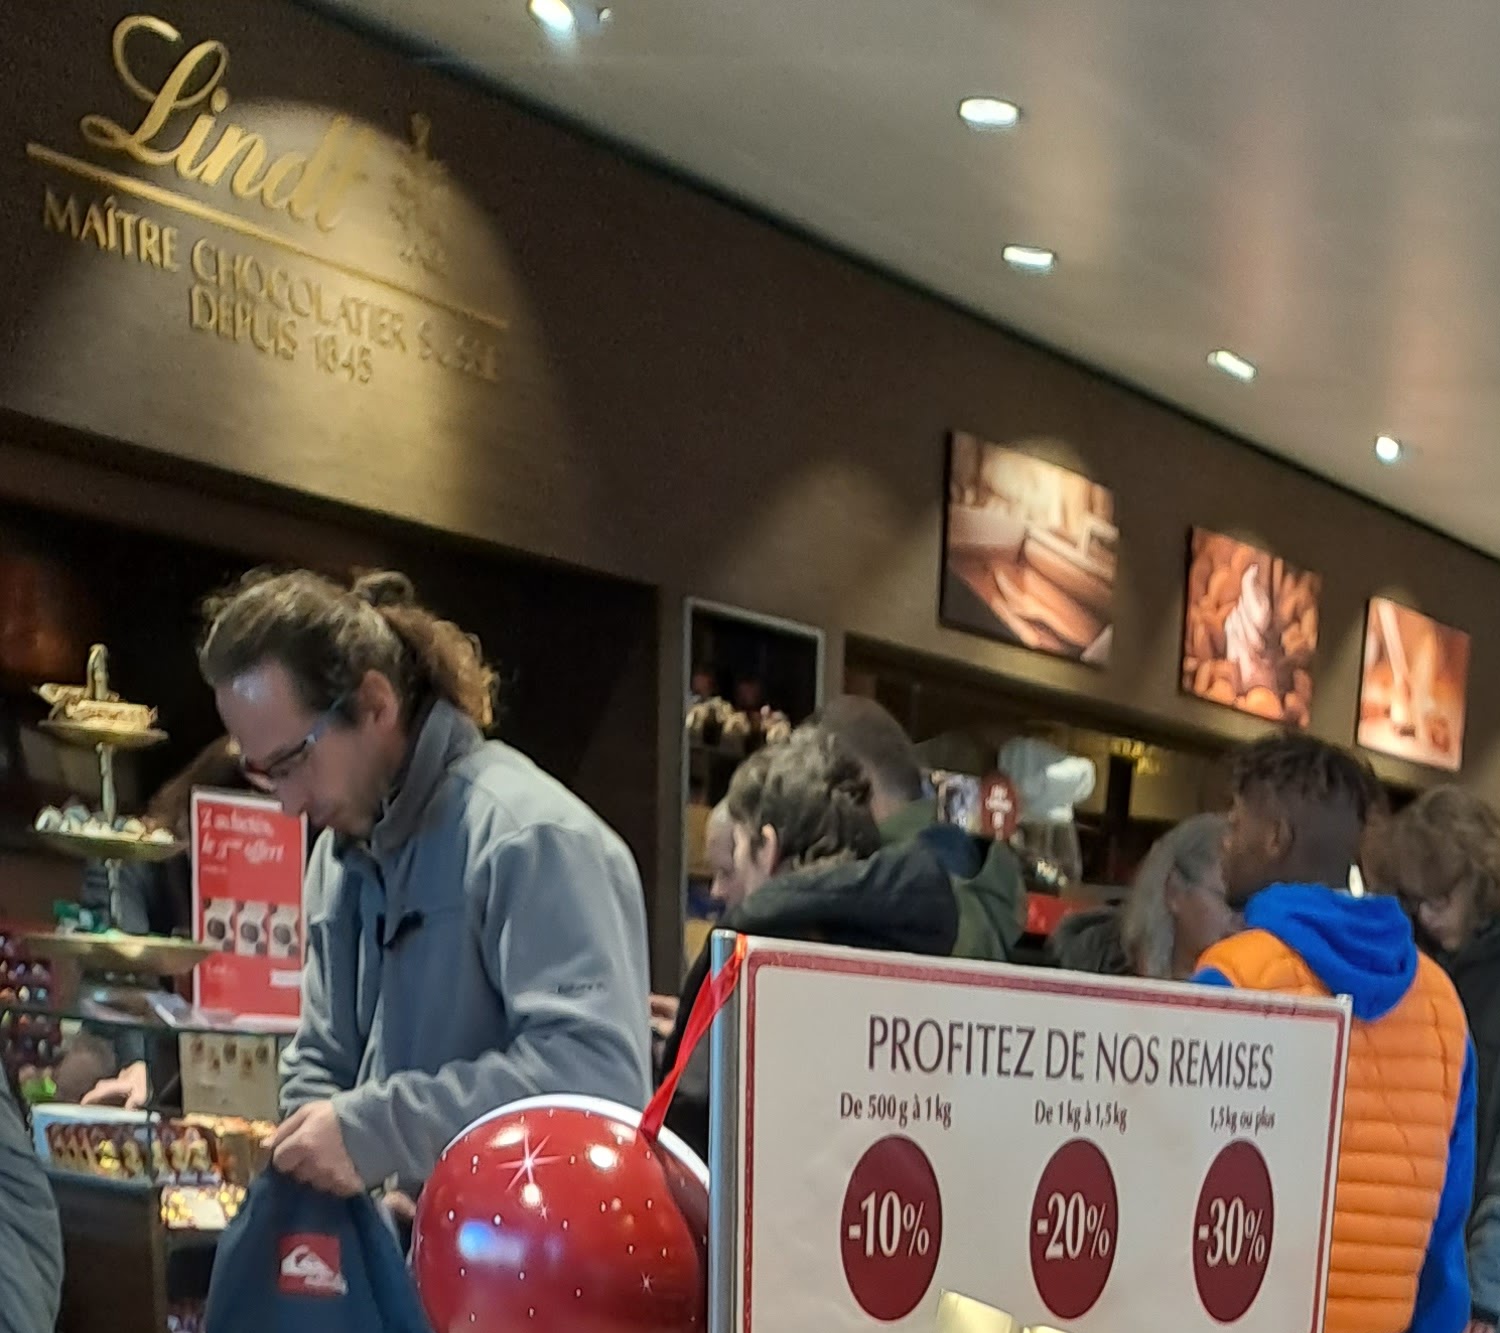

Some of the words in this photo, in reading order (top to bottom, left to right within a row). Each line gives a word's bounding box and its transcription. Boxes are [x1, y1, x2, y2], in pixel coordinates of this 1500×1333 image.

[43, 190, 180, 273] MAÎTRE
[190, 282, 298, 360] DEPUIS
[867, 1014, 1036, 1078] PROFITEZ
[1046, 1028, 1087, 1081] DE
[1096, 1031, 1160, 1087] NOS
[1169, 1037, 1275, 1090] REMISES
[840, 1091, 862, 1120] De
[912, 1093, 921, 1121] à
[1034, 1099, 1054, 1125] De
[847, 1189, 930, 1260] -10%
[1036, 1191, 1111, 1262] -20%
[1198, 1196, 1266, 1268] -30%
